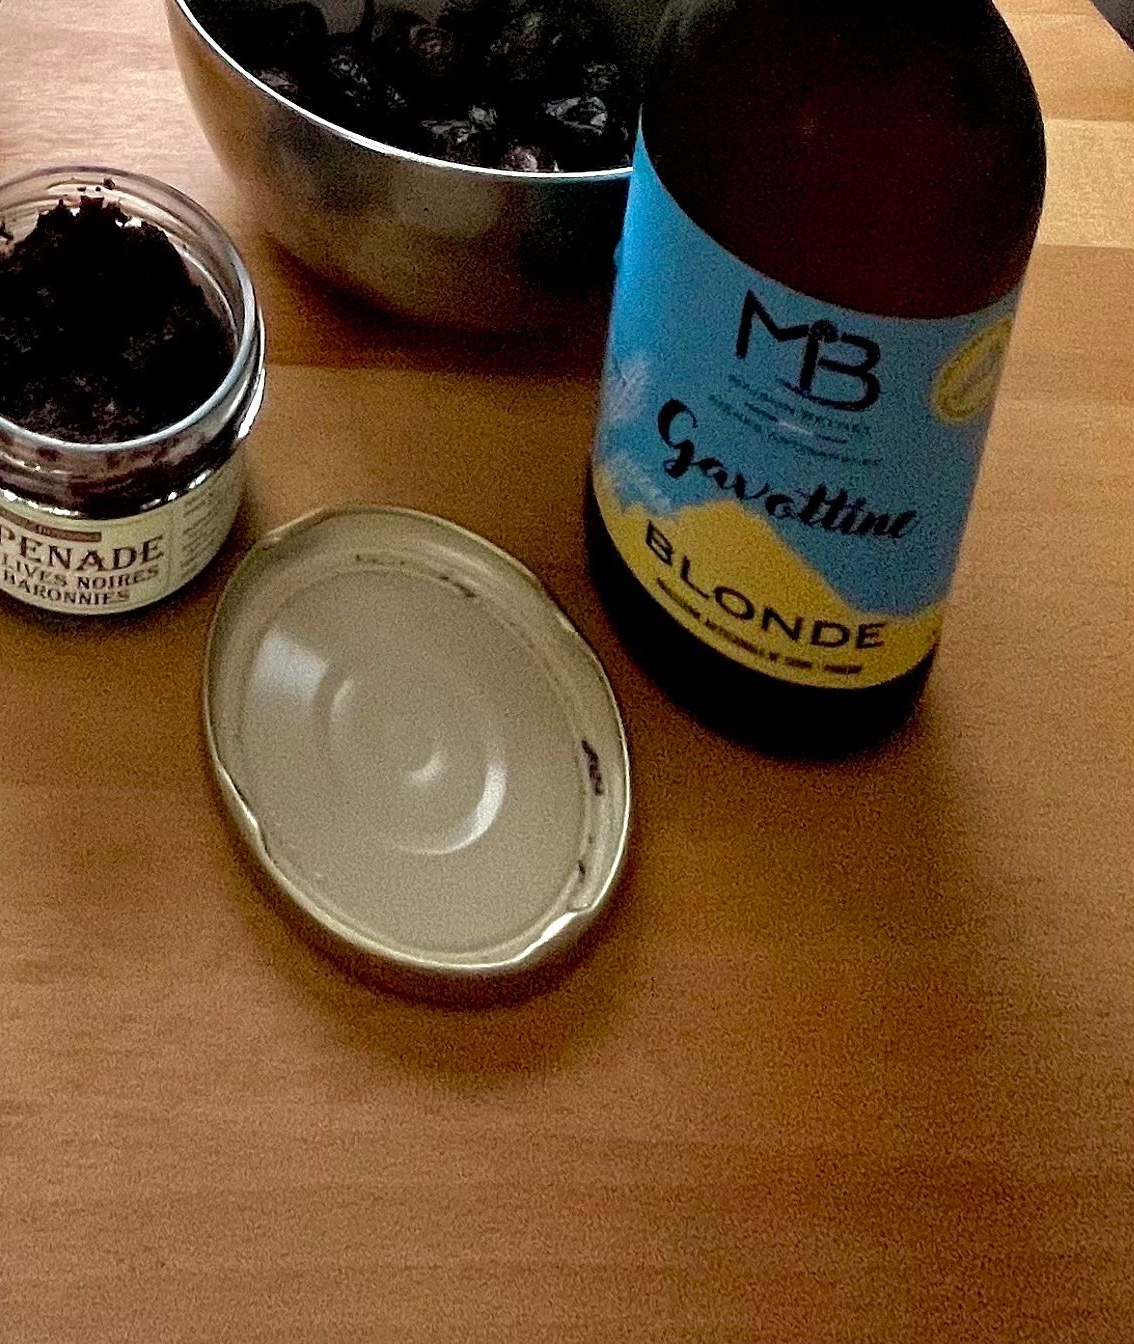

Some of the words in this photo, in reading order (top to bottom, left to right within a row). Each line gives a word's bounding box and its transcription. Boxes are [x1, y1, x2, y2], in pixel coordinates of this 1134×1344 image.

[735, 288, 883, 413] MB
[657, 398, 920, 540] Gavottine
[3, 568, 131, 606] BARONNIES
[77, 565, 160, 591] NOIRES
[645, 518, 886, 650] BLONDE
